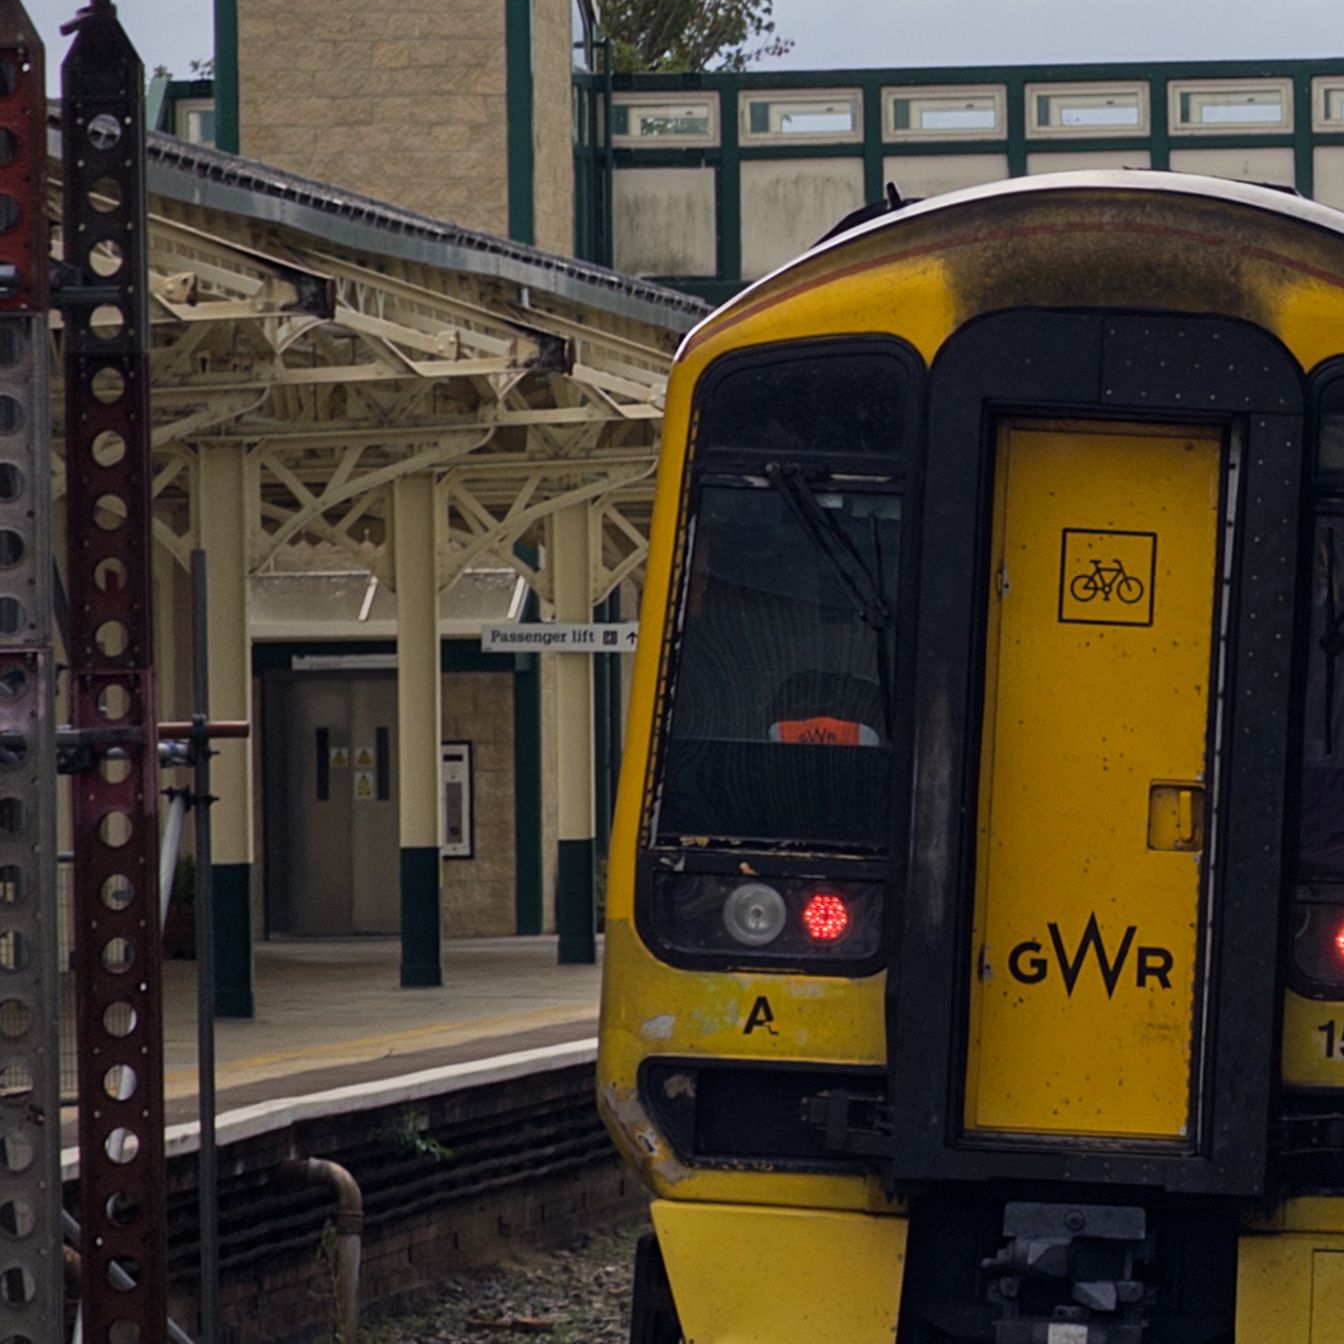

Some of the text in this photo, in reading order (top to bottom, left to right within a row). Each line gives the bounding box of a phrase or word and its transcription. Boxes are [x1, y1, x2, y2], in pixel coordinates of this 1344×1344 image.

[491, 630, 595, 645] Passenger lift
[1008, 910, 1173, 1000] GWR
[743, 995, 779, 1035] A
